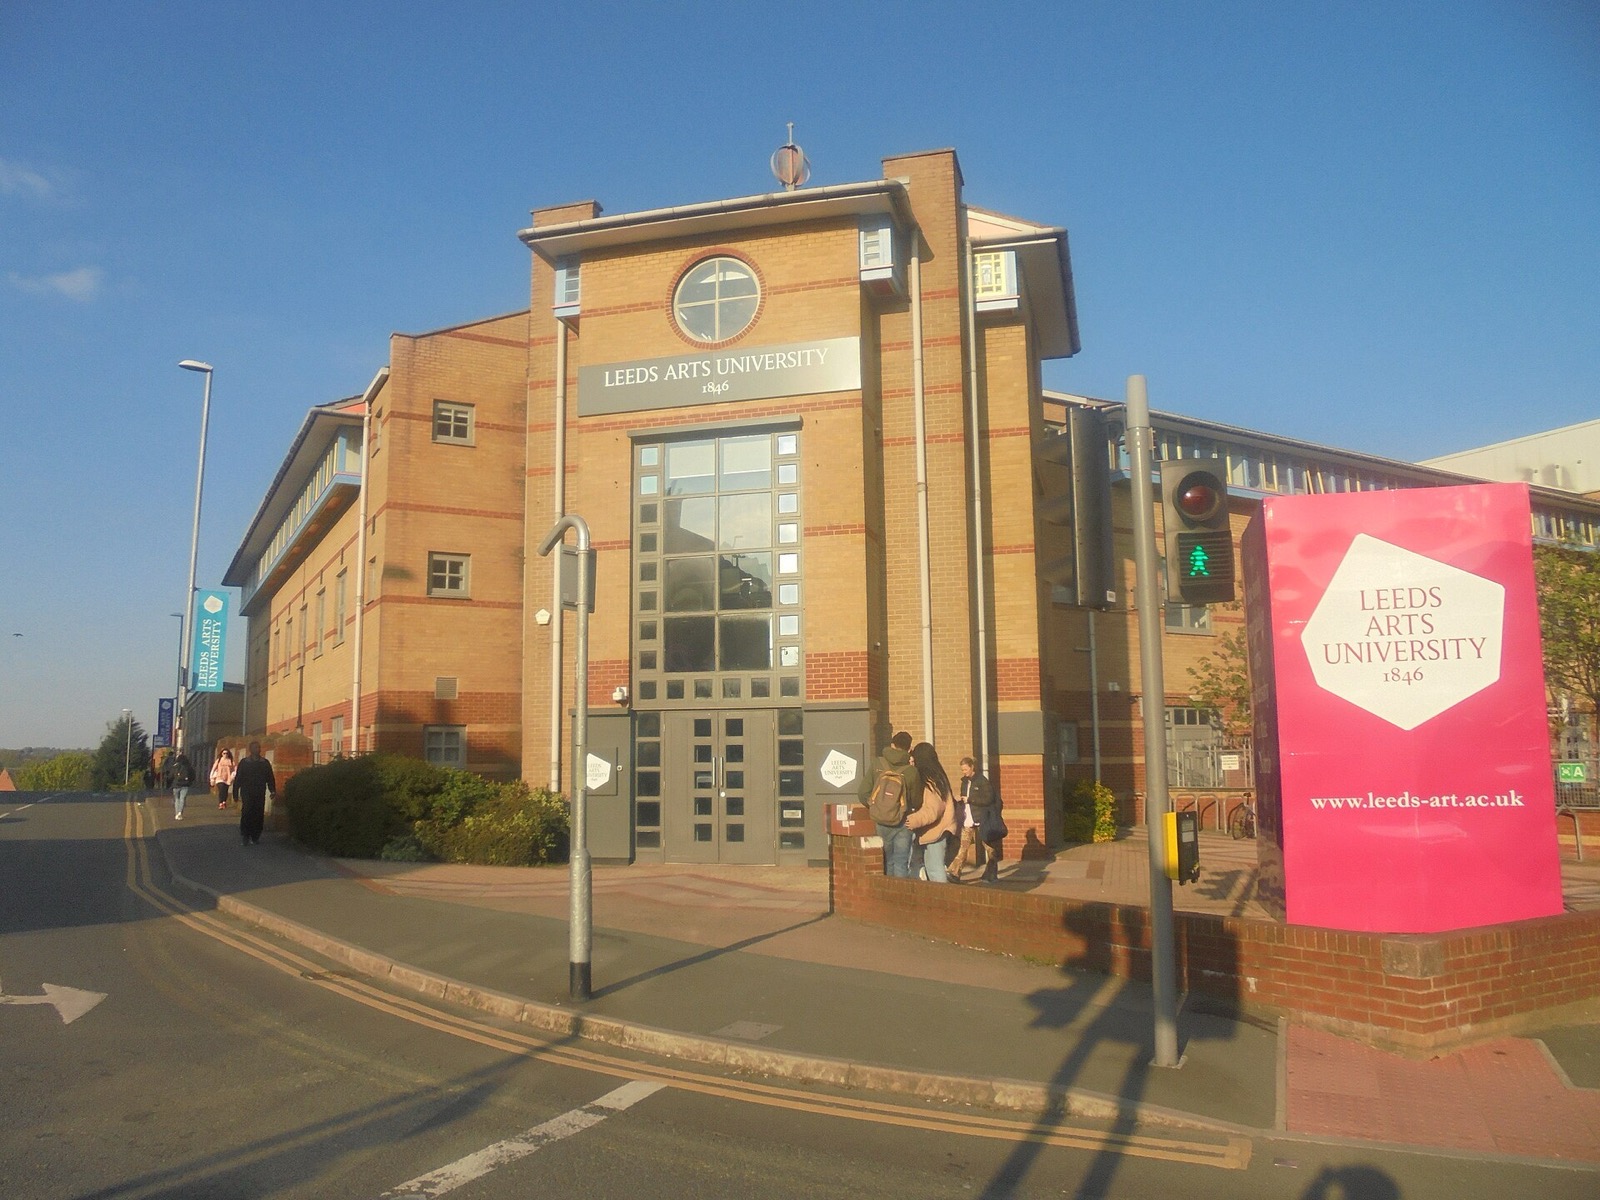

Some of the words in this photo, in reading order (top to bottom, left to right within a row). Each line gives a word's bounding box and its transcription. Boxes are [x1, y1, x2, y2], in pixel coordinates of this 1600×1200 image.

[604, 366, 659, 387] LEEDS
[663, 360, 711, 381] ARTS
[716, 347, 829, 375] UNIVERSITY
[702, 380, 730, 395] 1846
[1359, 586, 1442, 611] LEEDS
[202, 618, 212, 646] ARTS
[1364, 613, 1434, 637] ARTS
[208, 620, 222, 688] UNIVERSITY
[1322, 637, 1487, 665] UNIVERSITY
[198, 651, 210, 688] LEEDS
[1383, 667, 1424, 686] 1846
[1573, 766, 1584, 777] A
[1310, 789, 1526, 810] www.leeds-art.ac.uk
